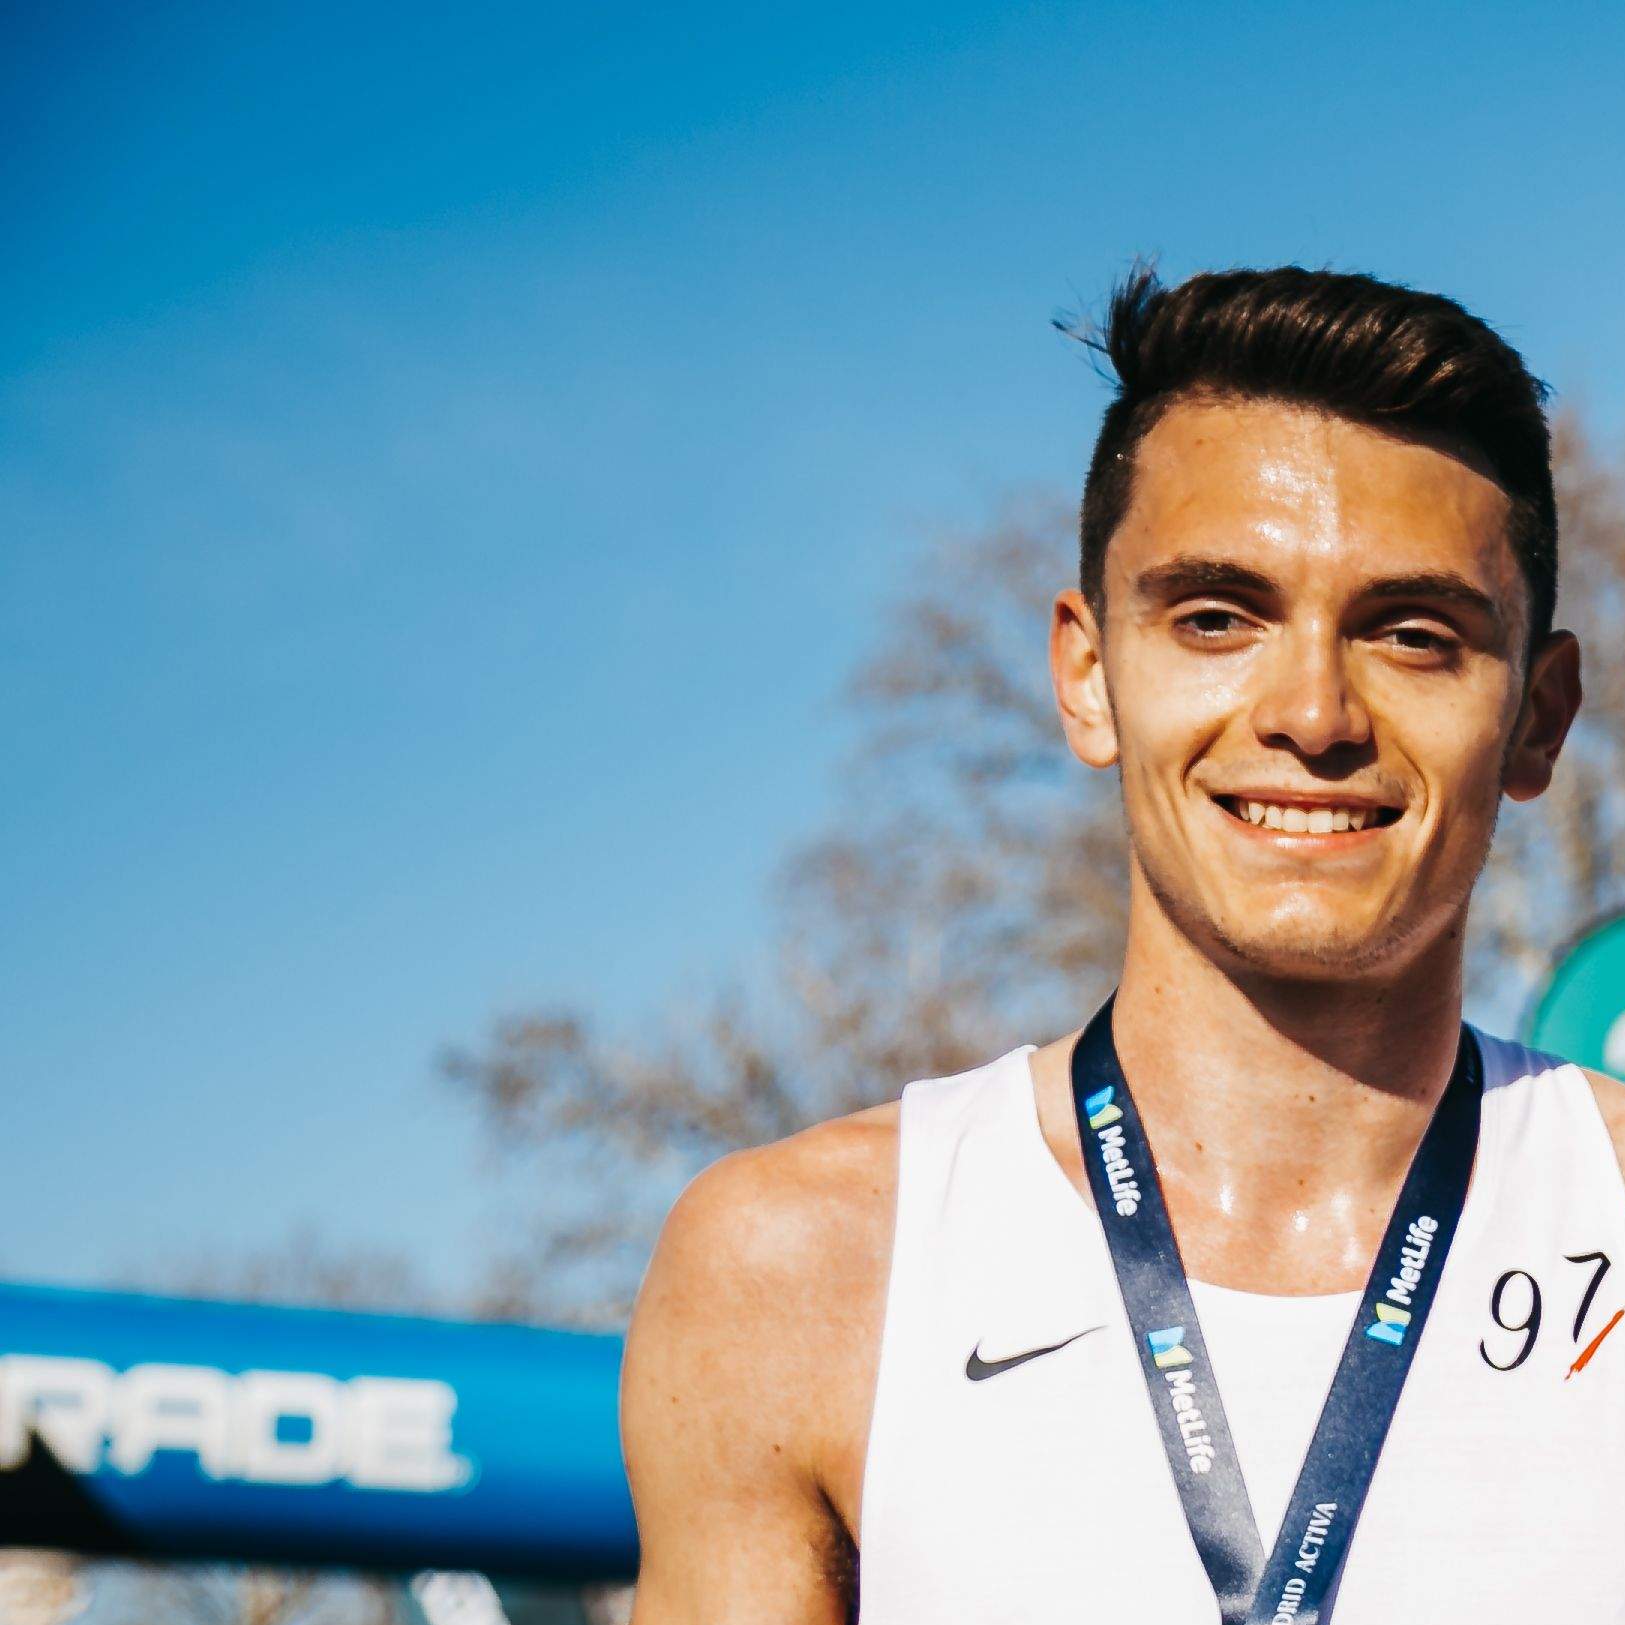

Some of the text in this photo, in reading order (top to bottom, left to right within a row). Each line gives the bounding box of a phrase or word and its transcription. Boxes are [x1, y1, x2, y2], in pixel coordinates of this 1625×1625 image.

[1097, 1125, 1142, 1218] MetLife
[1386, 1214, 1440, 1305] MetLife
[1479, 1250, 1612, 1373] 97
[1165, 1368, 1213, 1476] MetLife
[1294, 1501, 1338, 1574] ACTIVA
